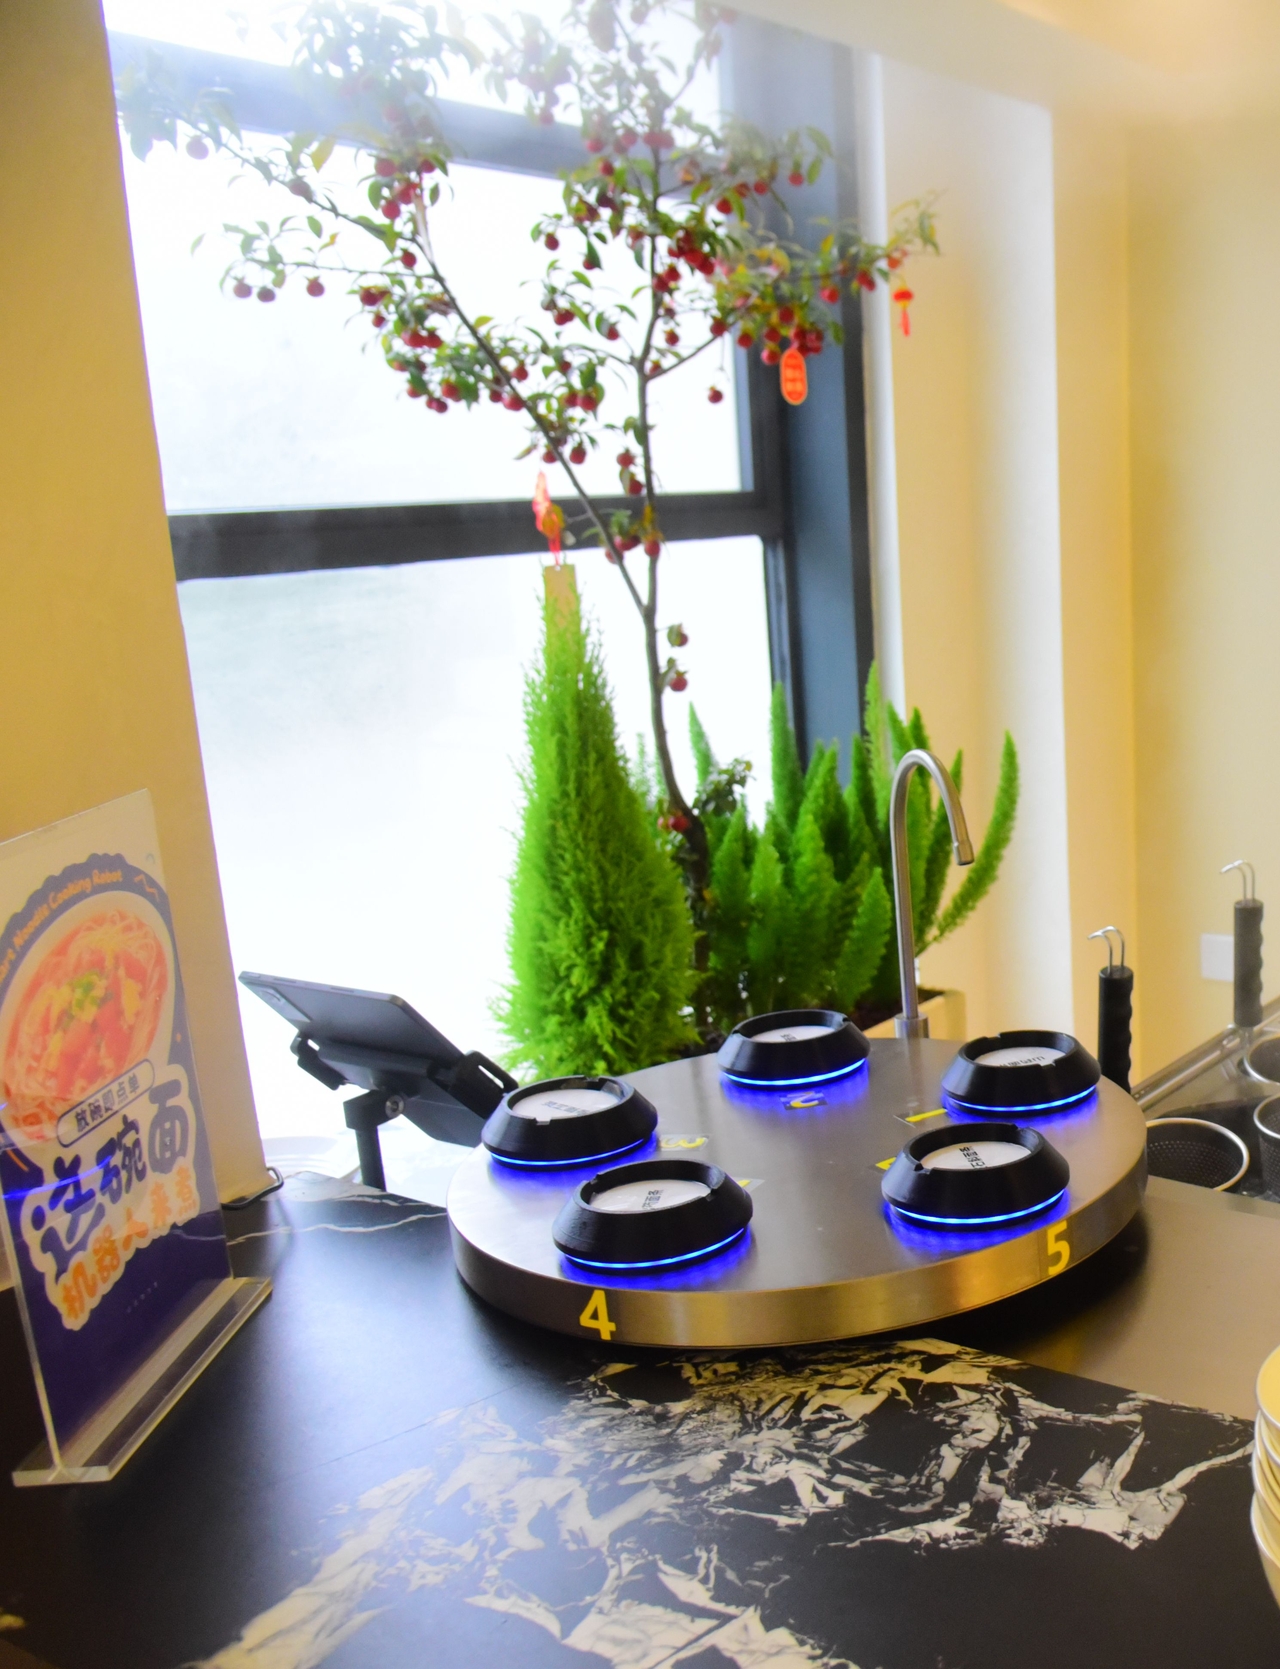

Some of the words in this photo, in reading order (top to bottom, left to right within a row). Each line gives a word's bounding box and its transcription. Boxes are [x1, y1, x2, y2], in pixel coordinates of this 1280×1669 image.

[92, 869, 122, 885] Robot
[61, 1164, 196, 1321] 机器人来煮
[1047, 1219, 1070, 1276] 5
[579, 1289, 616, 1341] 4
